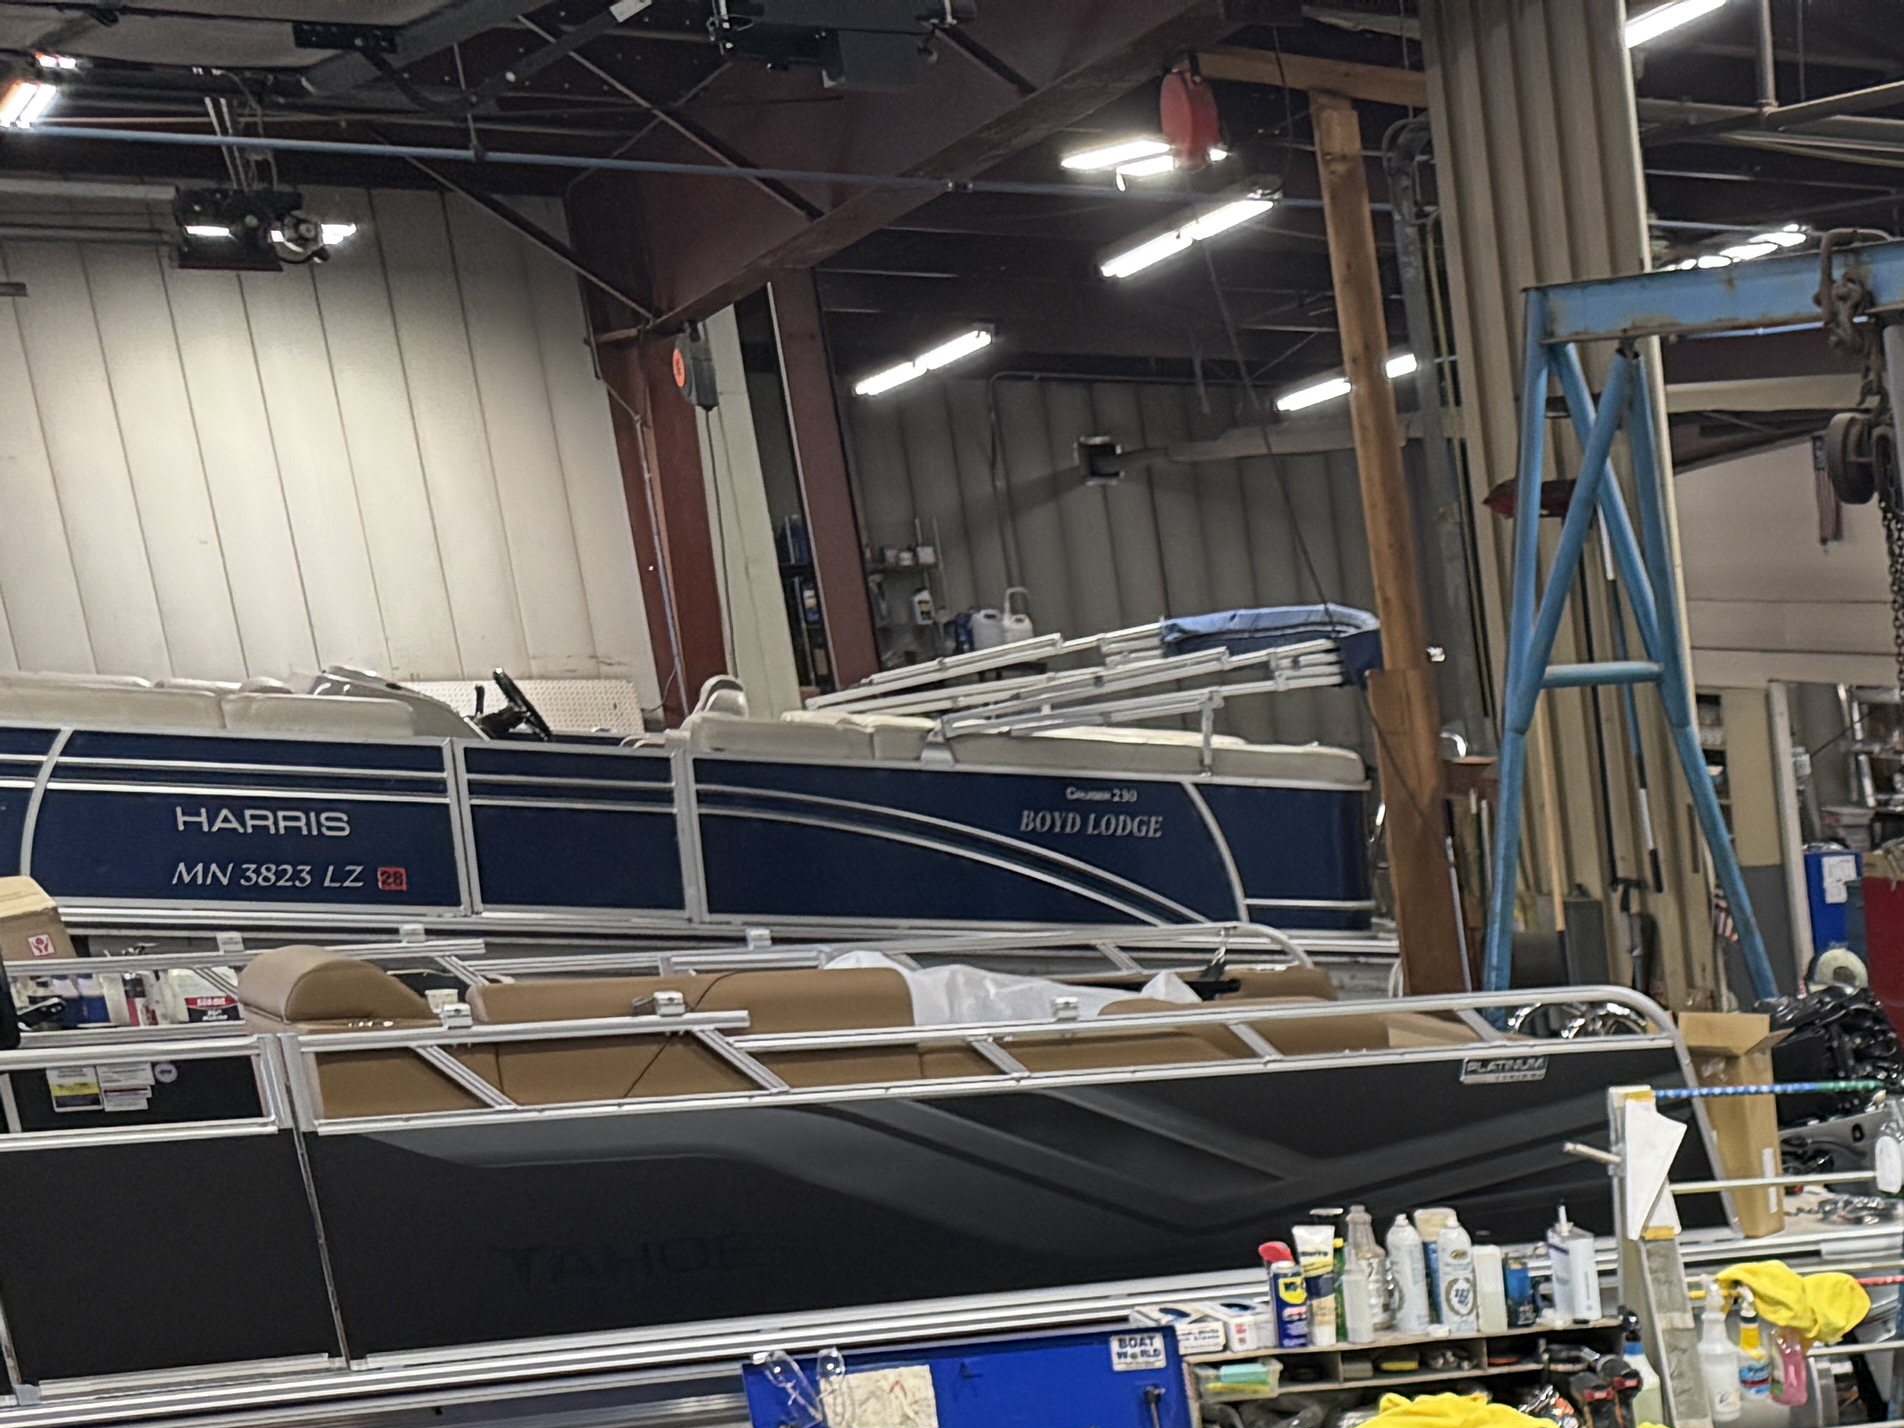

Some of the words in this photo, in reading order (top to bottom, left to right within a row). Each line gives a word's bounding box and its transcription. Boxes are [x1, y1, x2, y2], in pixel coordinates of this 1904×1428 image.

[175, 806, 351, 837] HARRIS
[1019, 809, 1082, 834] BOYD
[1086, 813, 1164, 838] LODGE
[171, 861, 235, 886] MN
[239, 863, 313, 888] 3823
[323, 864, 365, 888] LZ
[1117, 1334, 1156, 1349] BOAT
